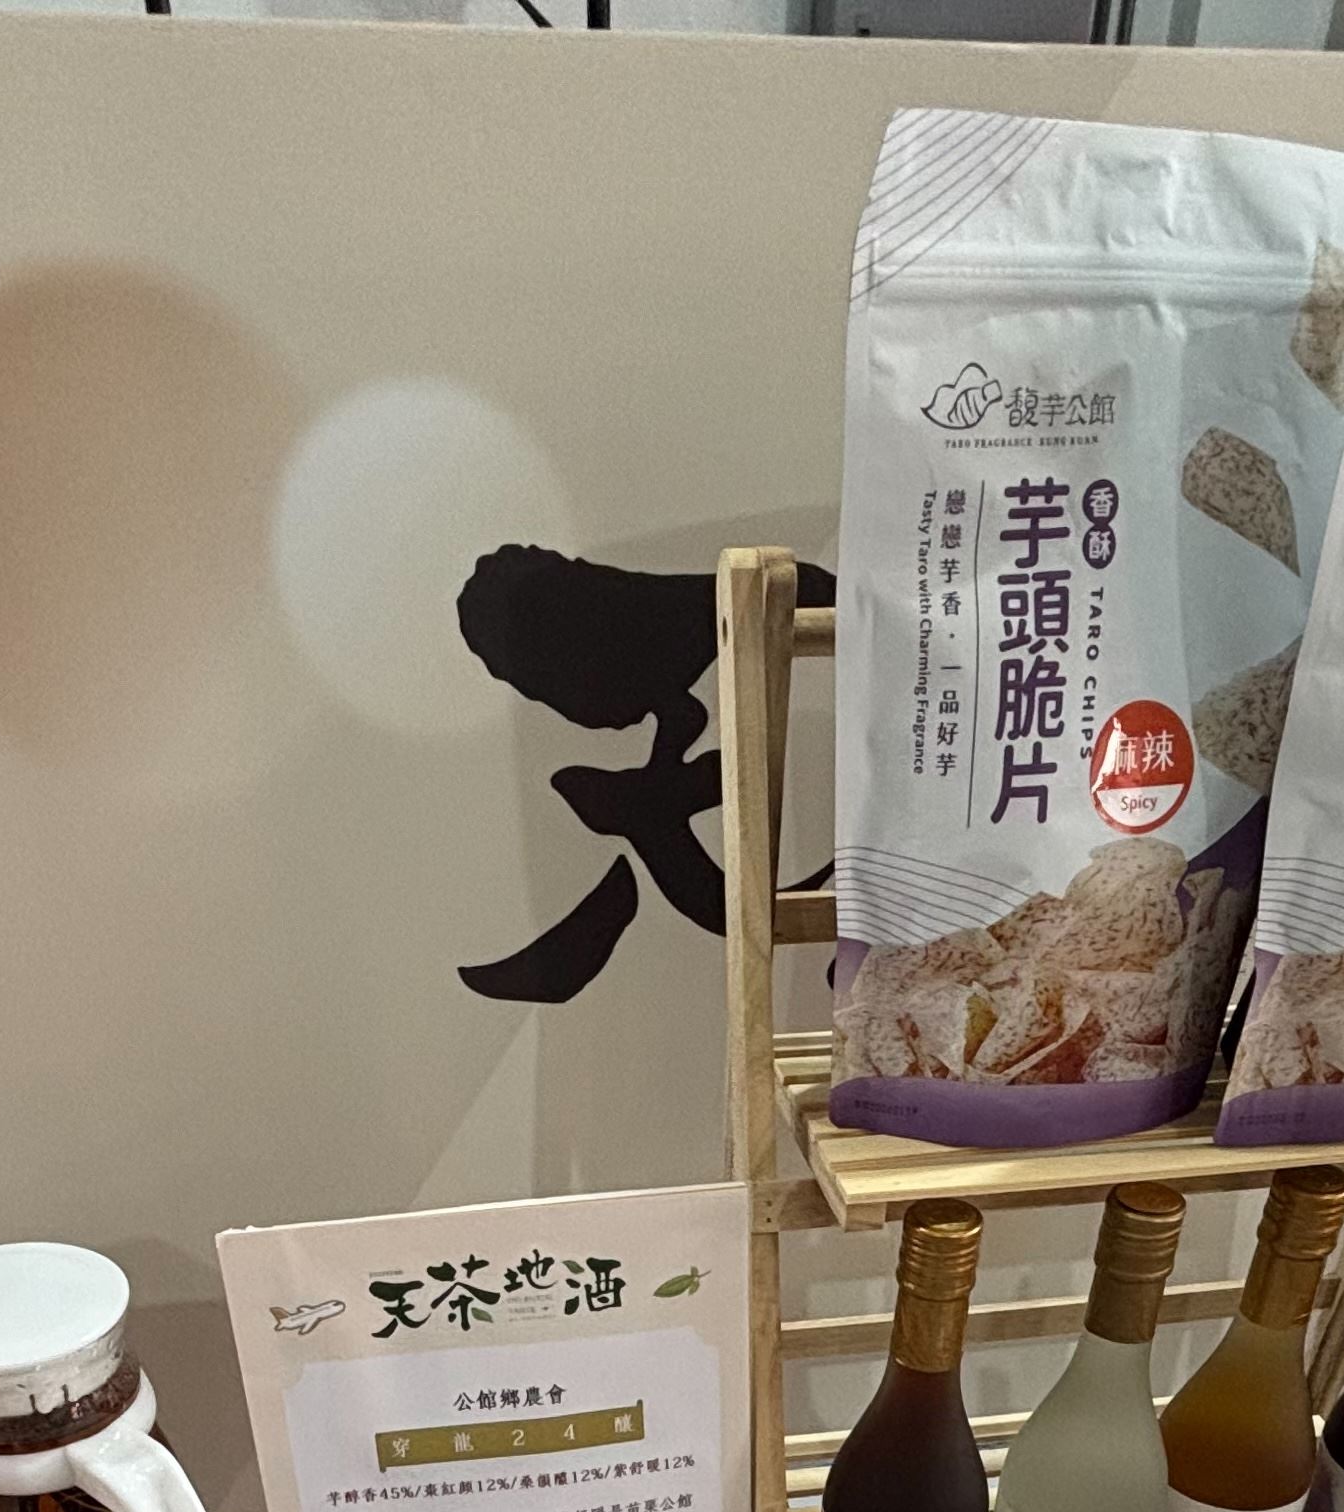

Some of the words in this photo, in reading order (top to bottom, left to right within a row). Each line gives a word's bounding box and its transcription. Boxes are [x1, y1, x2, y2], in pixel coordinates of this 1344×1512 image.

[1005, 386, 1117, 428] 馥芋公館
[918, 490, 937, 536] Tasty
[1088, 485, 1114, 562] 香酥
[918, 539, 932, 576] Taro
[918, 580, 931, 609] with
[914, 614, 932, 695] Charming
[990, 476, 1072, 824] 芋頭脆片
[1086, 587, 1104, 661] TARO
[912, 699, 930, 775] Fragrance
[1080, 676, 1098, 761] CHIPS
[1120, 792, 1158, 812] Spicy
[368, 1248, 628, 1339] 天茶地酒
[454, 1382, 568, 1413] 公館鄉農會
